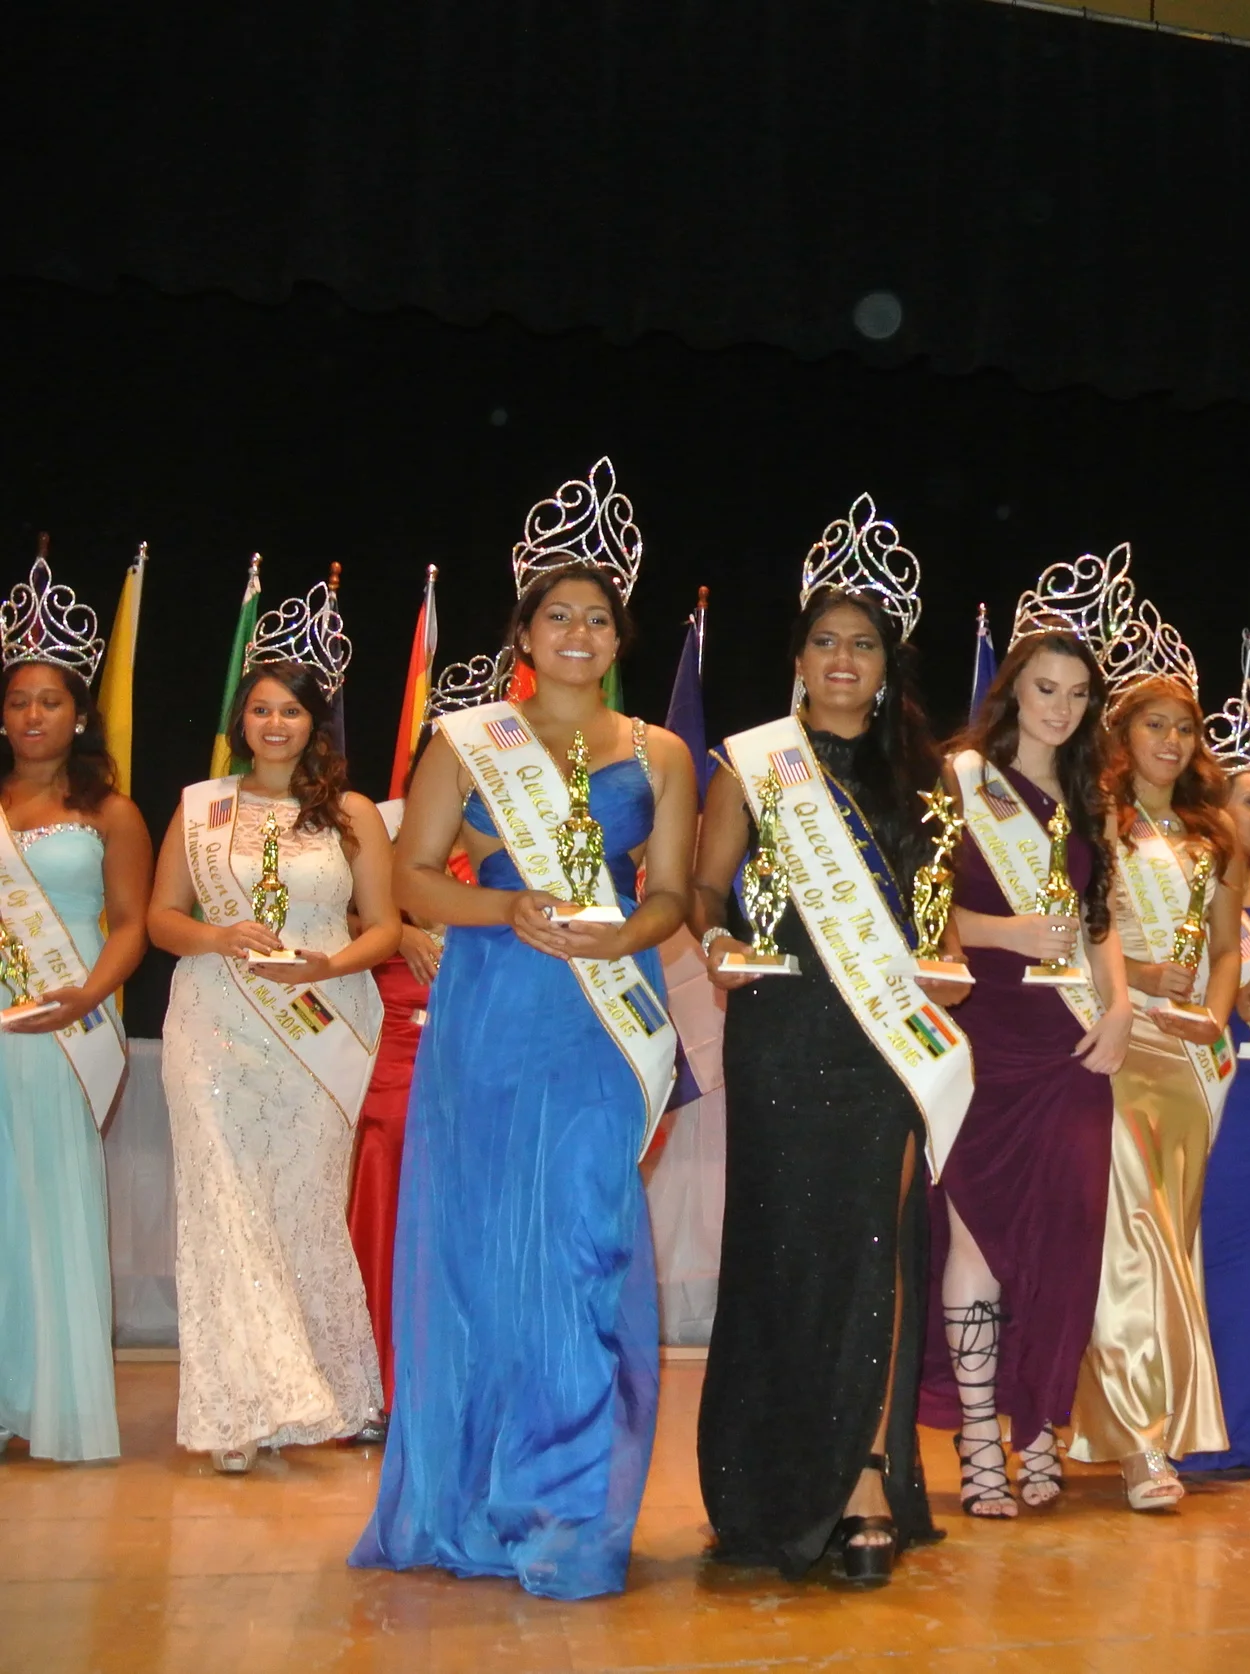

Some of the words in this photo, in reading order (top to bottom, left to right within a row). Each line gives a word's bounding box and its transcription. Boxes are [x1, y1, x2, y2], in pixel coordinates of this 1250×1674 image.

[463, 743, 536, 849] Anniversary
[526, 853, 550, 876] Of
[187, 819, 213, 905] Anniversary
[205, 842, 229, 898] Queen
[223, 899, 240, 918] Of
[1016, 839, 1049, 888] Quee
[794, 802, 842, 877] Queen
[832, 880, 858, 904] Of
[848, 908, 879, 944] The
[872, 952, 912, 1011] 15th
[802, 888, 824, 909] Of
[886, 1028, 924, 1068] 2015
[274, 1008, 307, 1041] 2015
